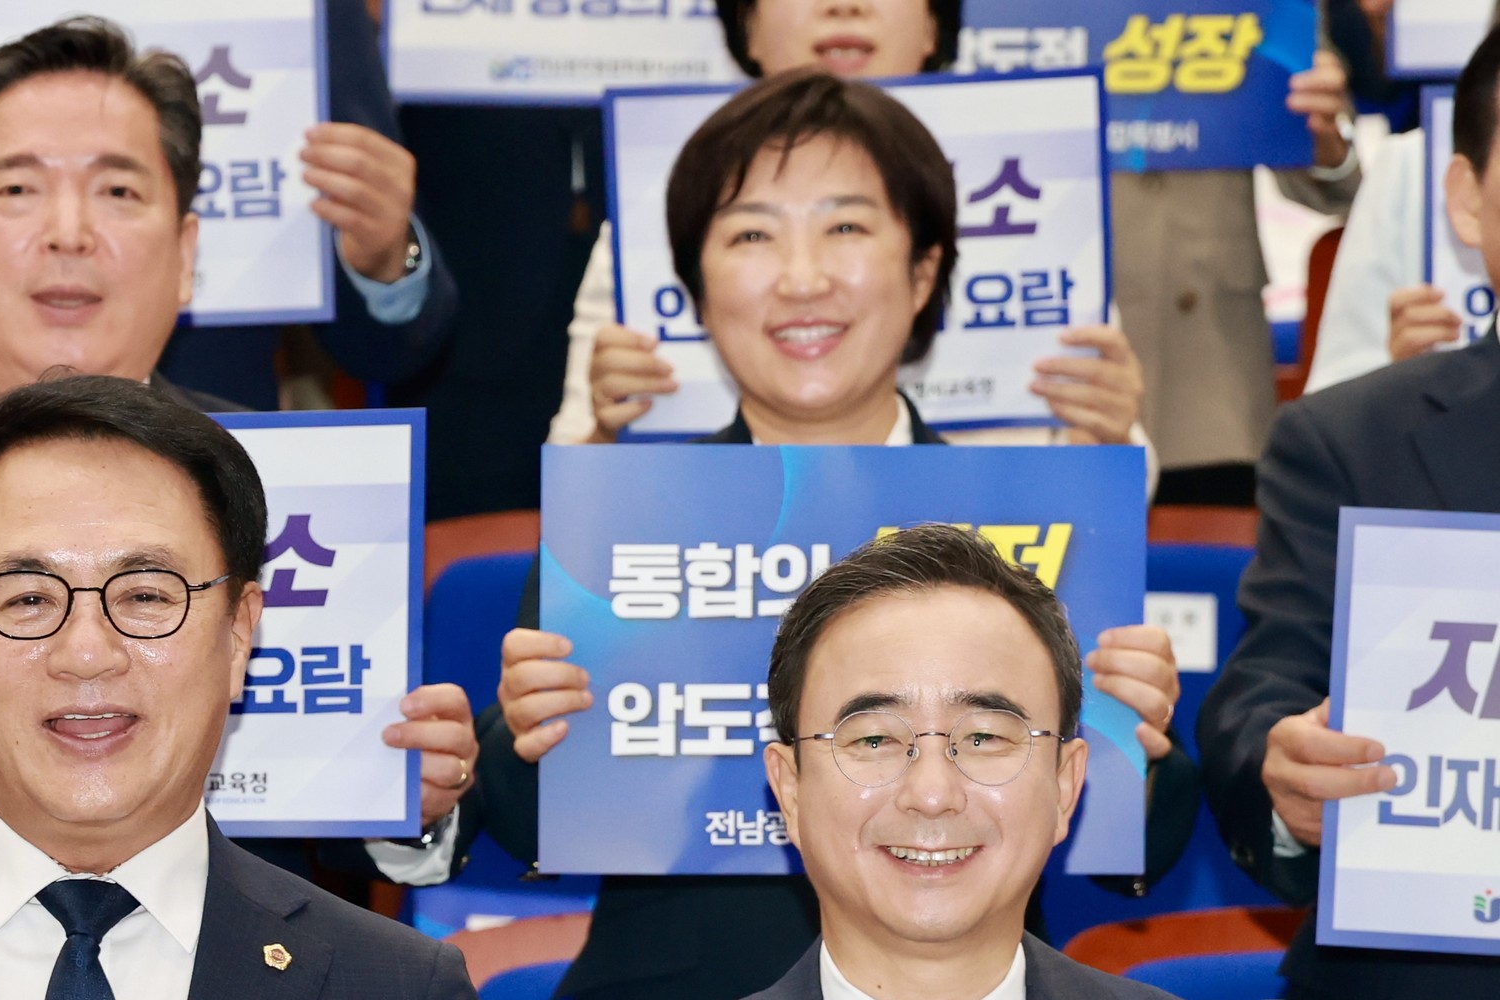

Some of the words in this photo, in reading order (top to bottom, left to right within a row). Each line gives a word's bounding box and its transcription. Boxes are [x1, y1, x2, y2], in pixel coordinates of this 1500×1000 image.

[1104, 13, 1263, 93] 성장
[964, 268, 1074, 327] 요람
[609, 542, 831, 619] 통합의
[229, 644, 371, 714] 요람
